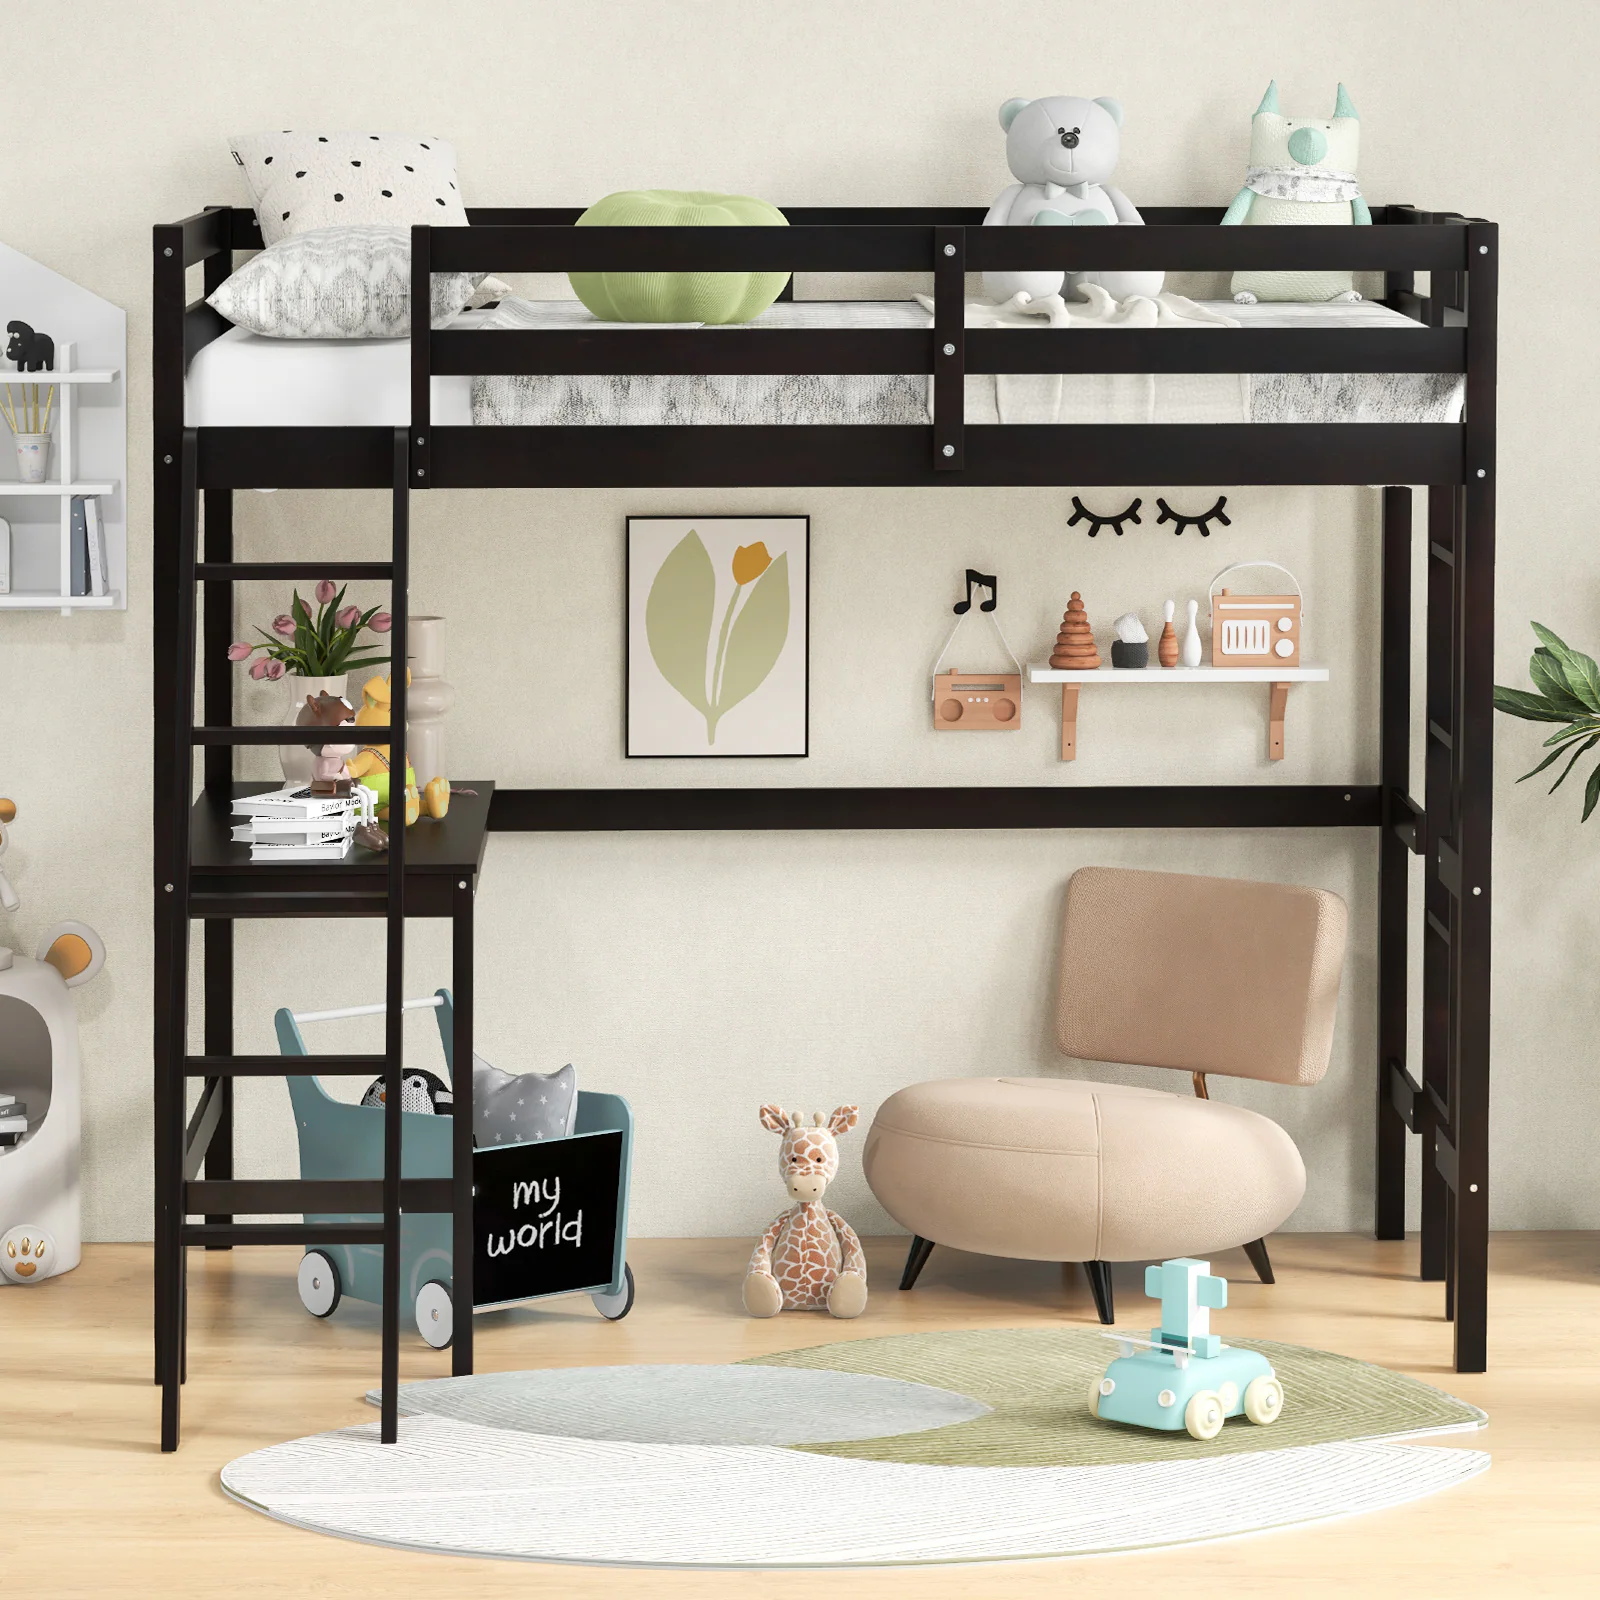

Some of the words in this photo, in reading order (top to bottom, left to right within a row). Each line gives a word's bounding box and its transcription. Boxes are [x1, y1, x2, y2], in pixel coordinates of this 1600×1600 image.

[321, 801, 342, 812] Baylor
[513, 1176, 560, 1218] my
[487, 1209, 582, 1257] world
